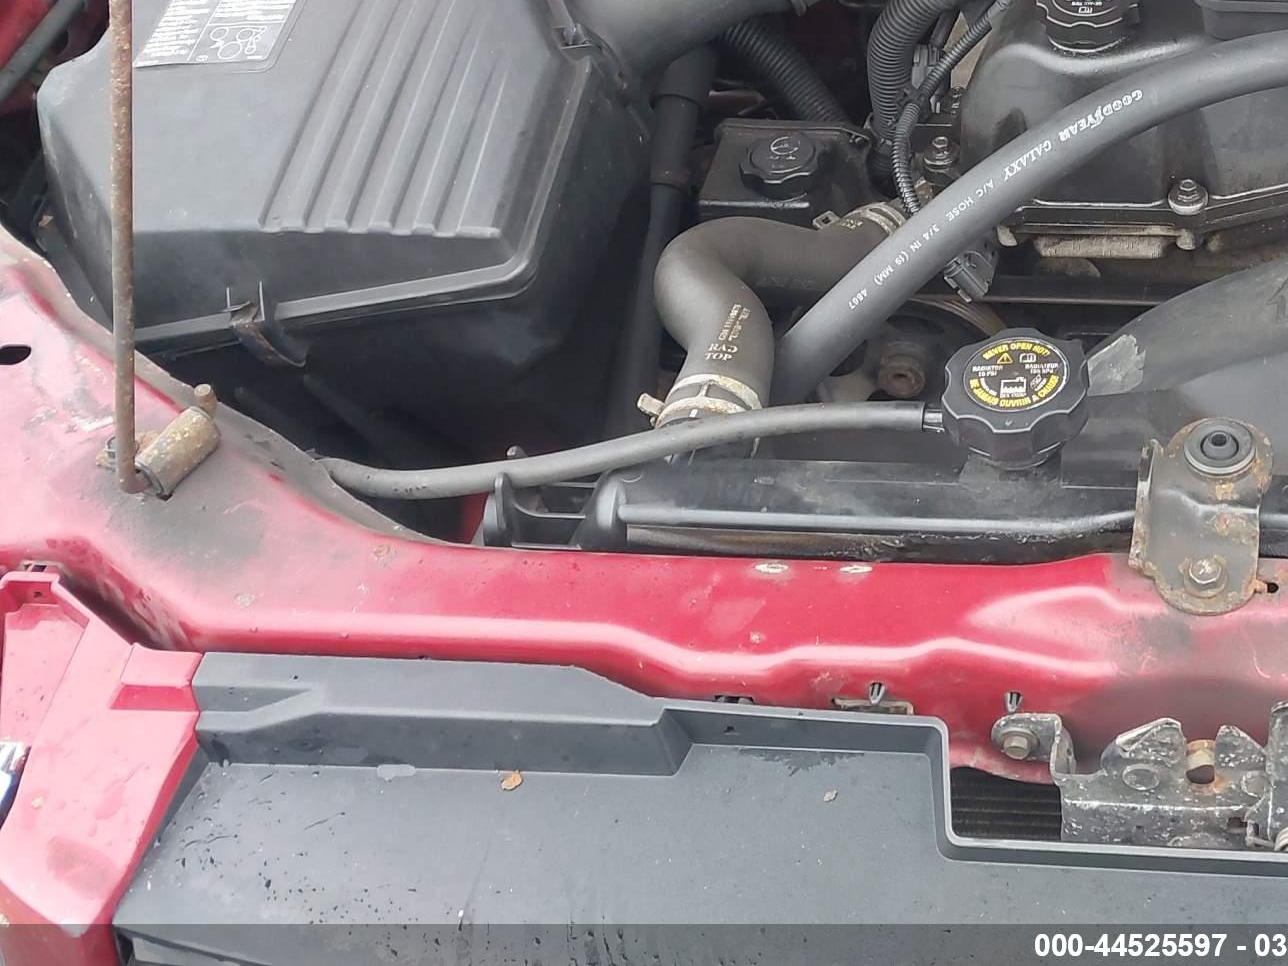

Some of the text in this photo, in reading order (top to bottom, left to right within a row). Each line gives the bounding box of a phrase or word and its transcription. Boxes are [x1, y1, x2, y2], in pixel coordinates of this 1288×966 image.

[1058, 89, 1143, 142] GOODYEAR
[1002, 140, 1052, 181] GALAXY
[974, 177, 995, 199] A/C
[944, 195, 974, 221] HOSE
[922, 223, 940, 240] 3/4
[909, 237, 922, 252] IN
[872, 265, 894, 286] MM)
[704, 352, 733, 362] TOP
[982, 344, 1009, 361] NEVER
[1010, 342, 1032, 351] OPEN
[972, 365, 1004, 373] RADIATOR
[1025, 362, 1059, 370] RADIATEUR
[973, 386, 999, 406] JAMAIS
[999, 397, 1032, 407] OUVRIR
